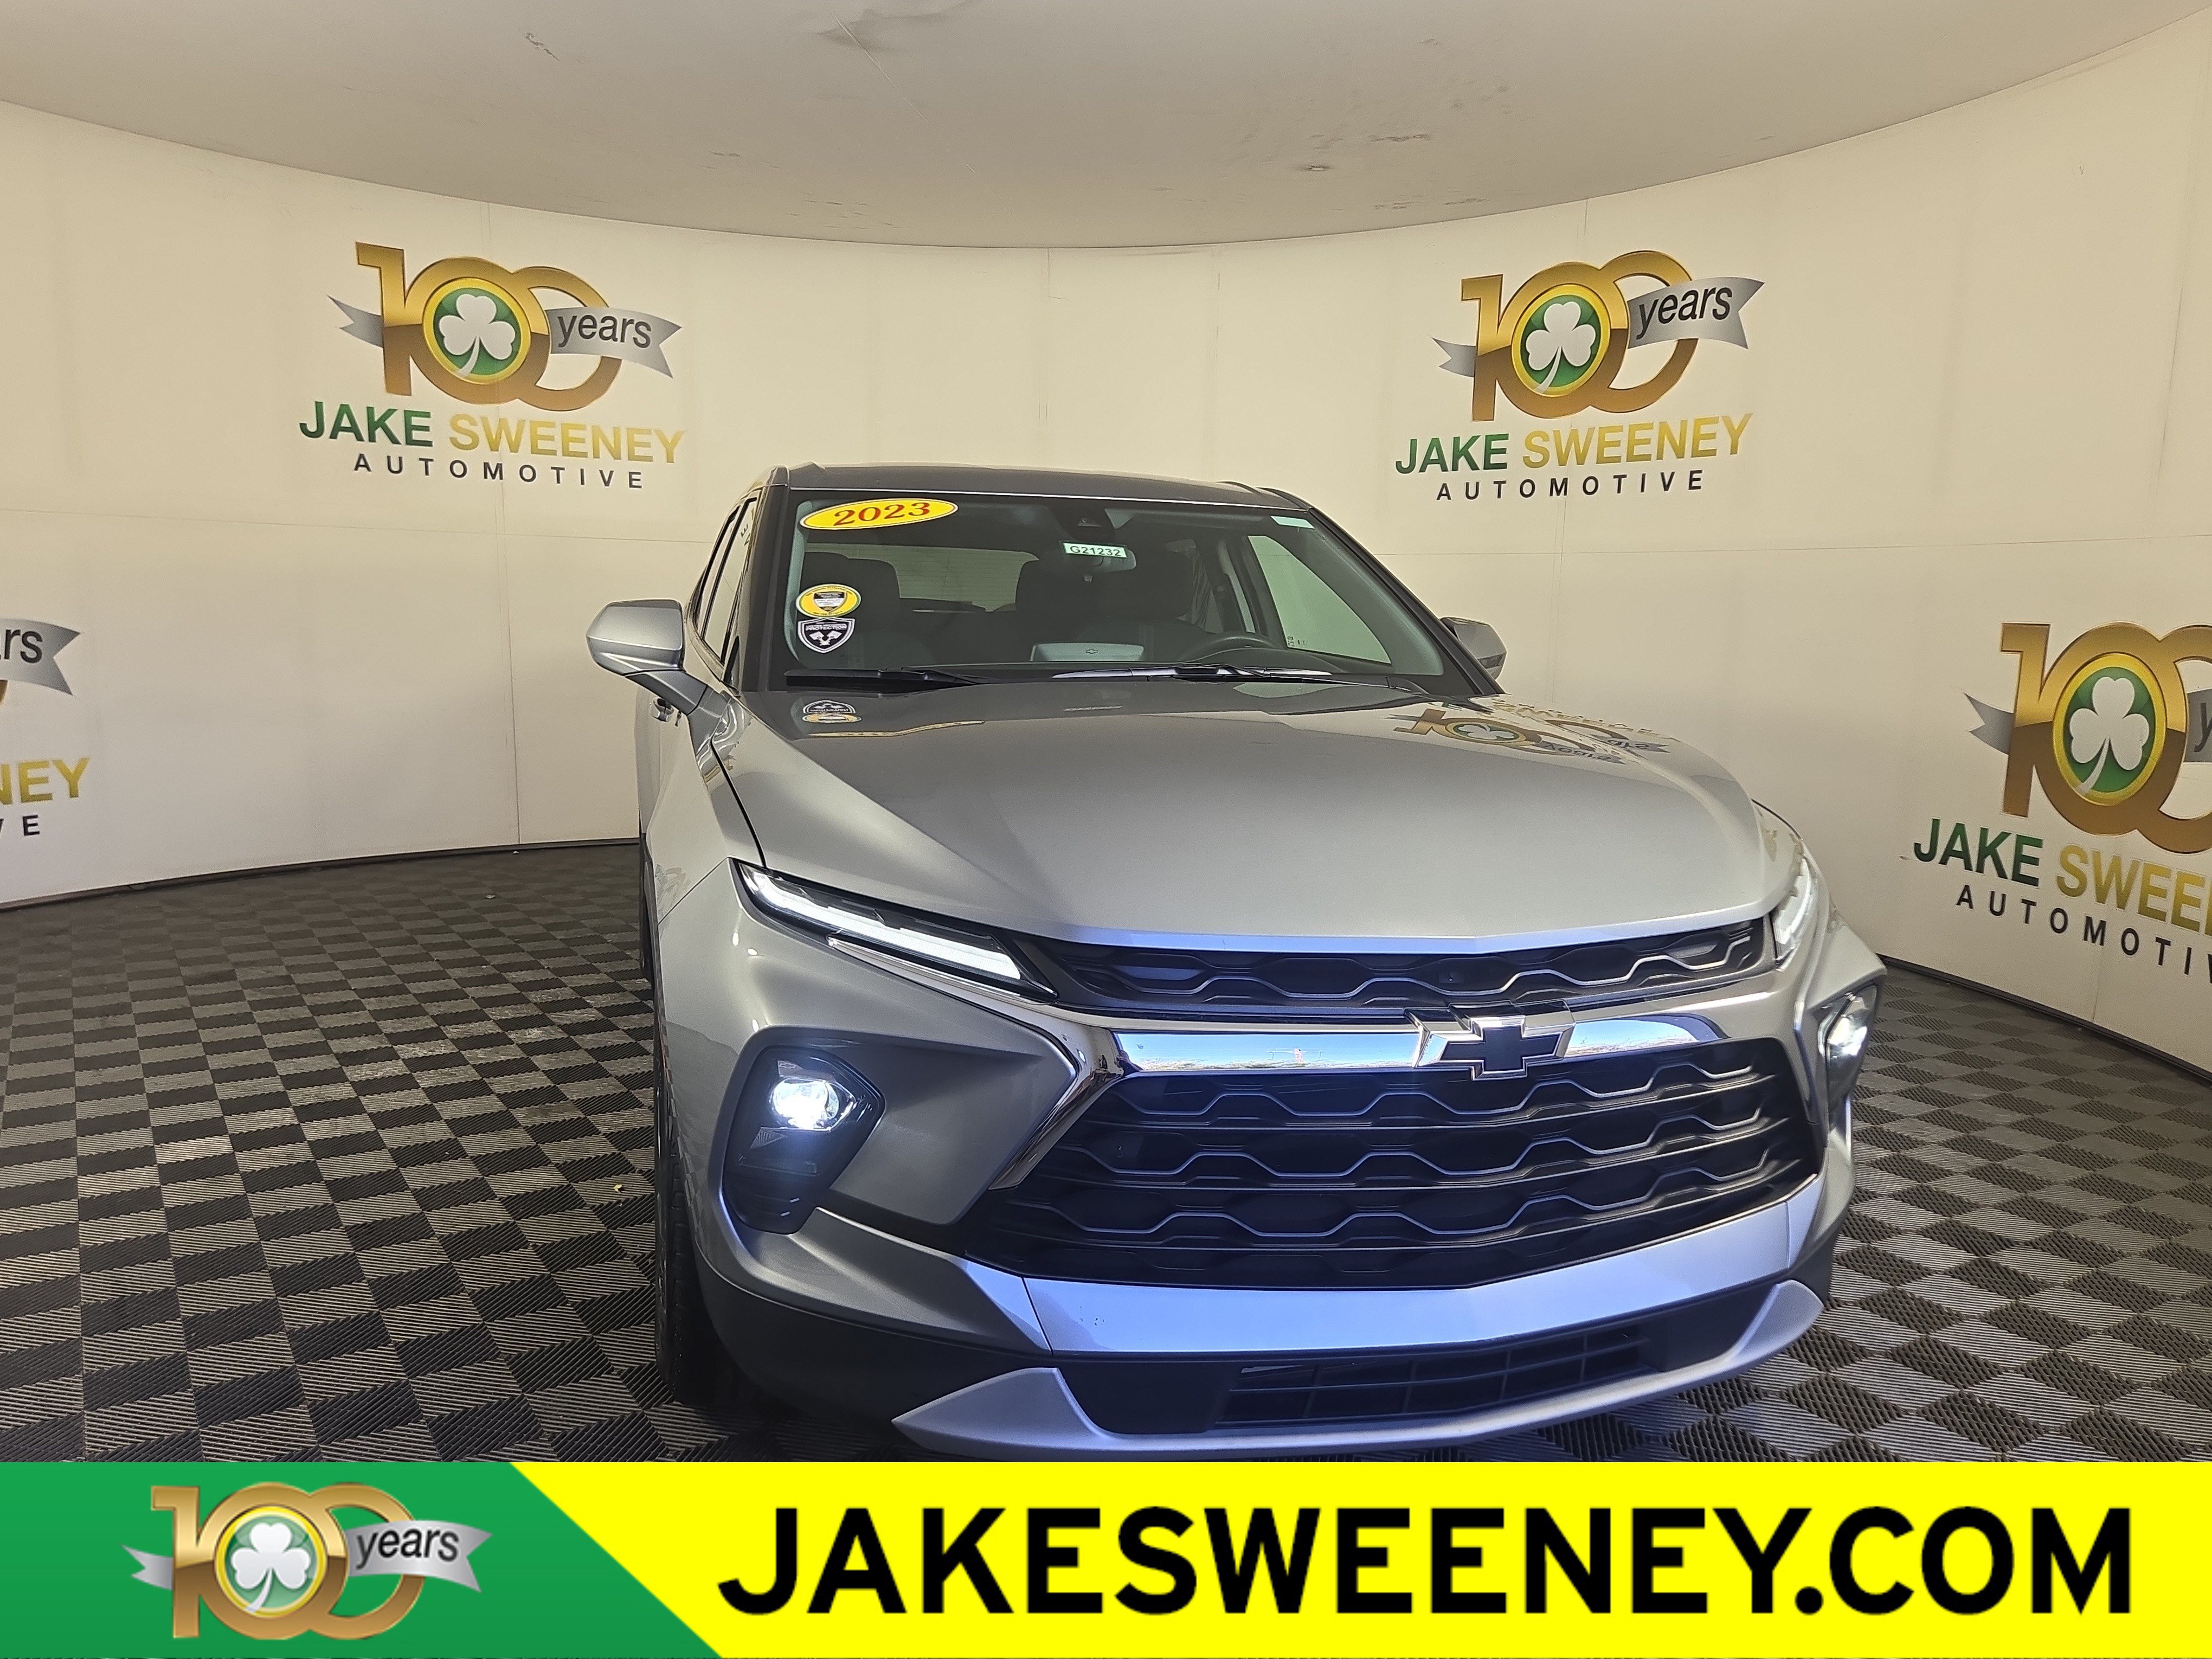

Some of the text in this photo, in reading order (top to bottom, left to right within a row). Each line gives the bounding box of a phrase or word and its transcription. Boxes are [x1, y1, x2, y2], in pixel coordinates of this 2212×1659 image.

[355, 241, 622, 411] 100
[557, 313, 652, 349] years
[1461, 250, 1699, 421] 100
[1636, 287, 1733, 339] years
[299, 401, 685, 464] JAKE SWEENEY
[1396, 413, 1753, 474] JAKE SWEENEY
[353, 453, 642, 488] AUTOMOTIVE
[1436, 470, 1704, 501] AUTOMOTIVE
[833, 502, 930, 526] 2023
[1070, 545, 1122, 557] G21232
[1913, 818, 2212, 936] JAKE SWEE
[1957, 885, 2212, 984] AUTOMOTI
